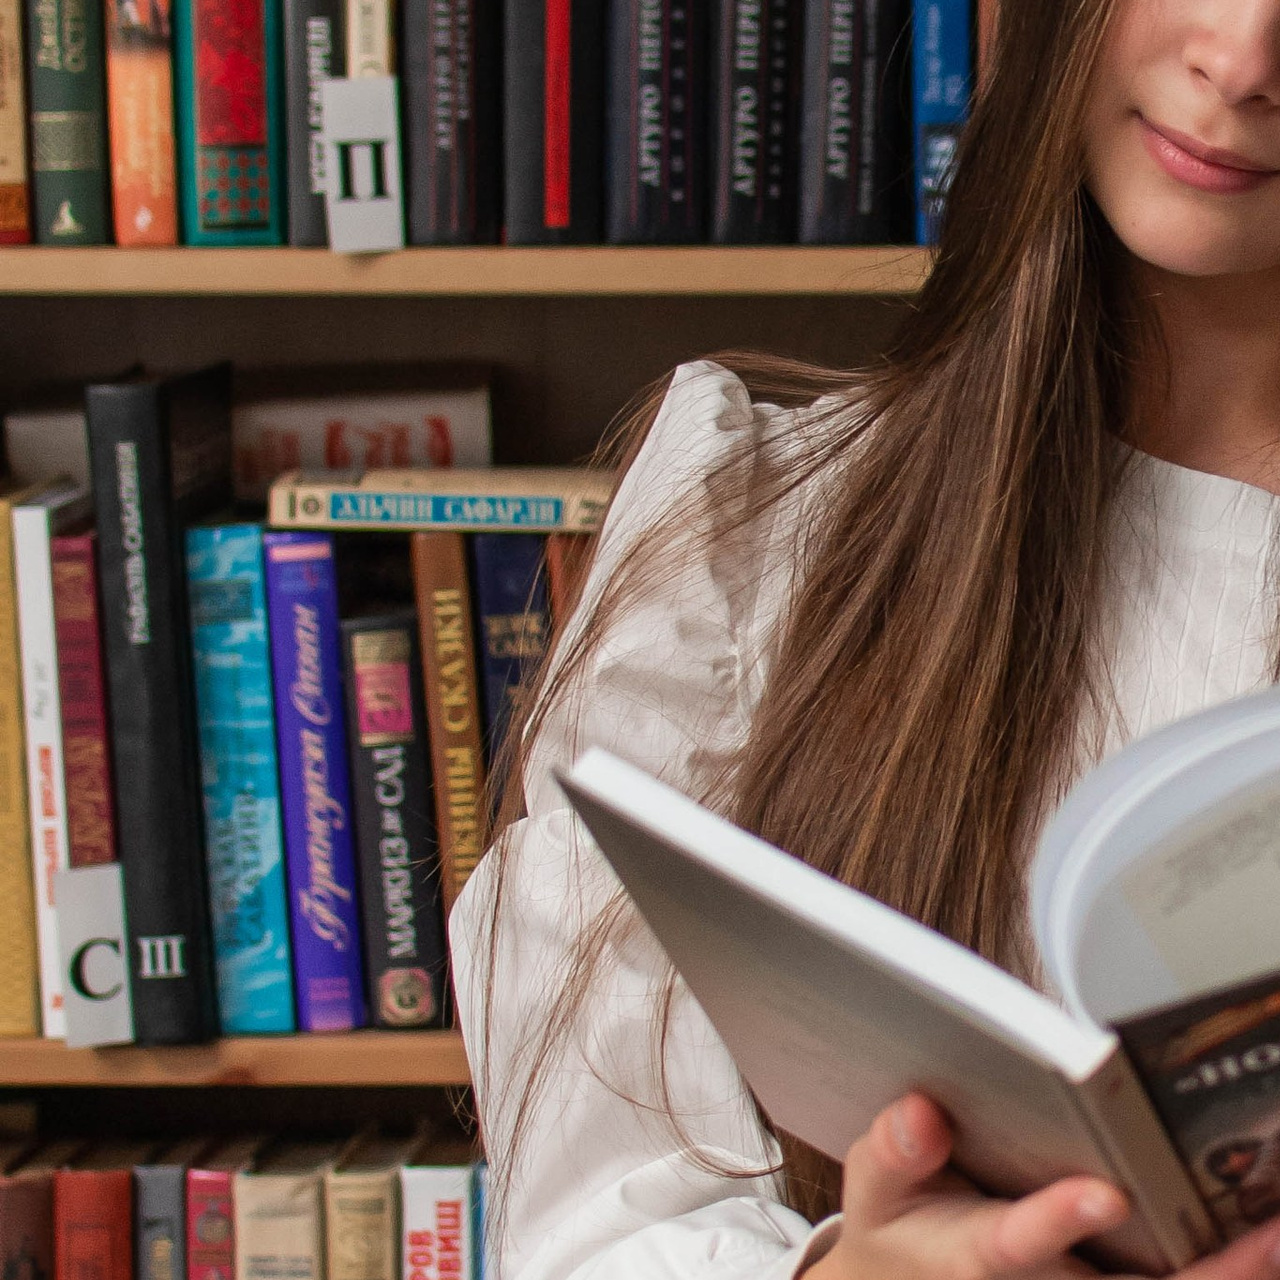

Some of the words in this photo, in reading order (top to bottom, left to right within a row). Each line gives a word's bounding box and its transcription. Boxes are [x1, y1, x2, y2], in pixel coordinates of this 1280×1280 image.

[335, 138, 389, 201] П
[733, 86, 760, 197] АРТУРО
[433, 588, 471, 733] СКАЗКИ
[379, 838, 417, 959] МАРКИЗ
